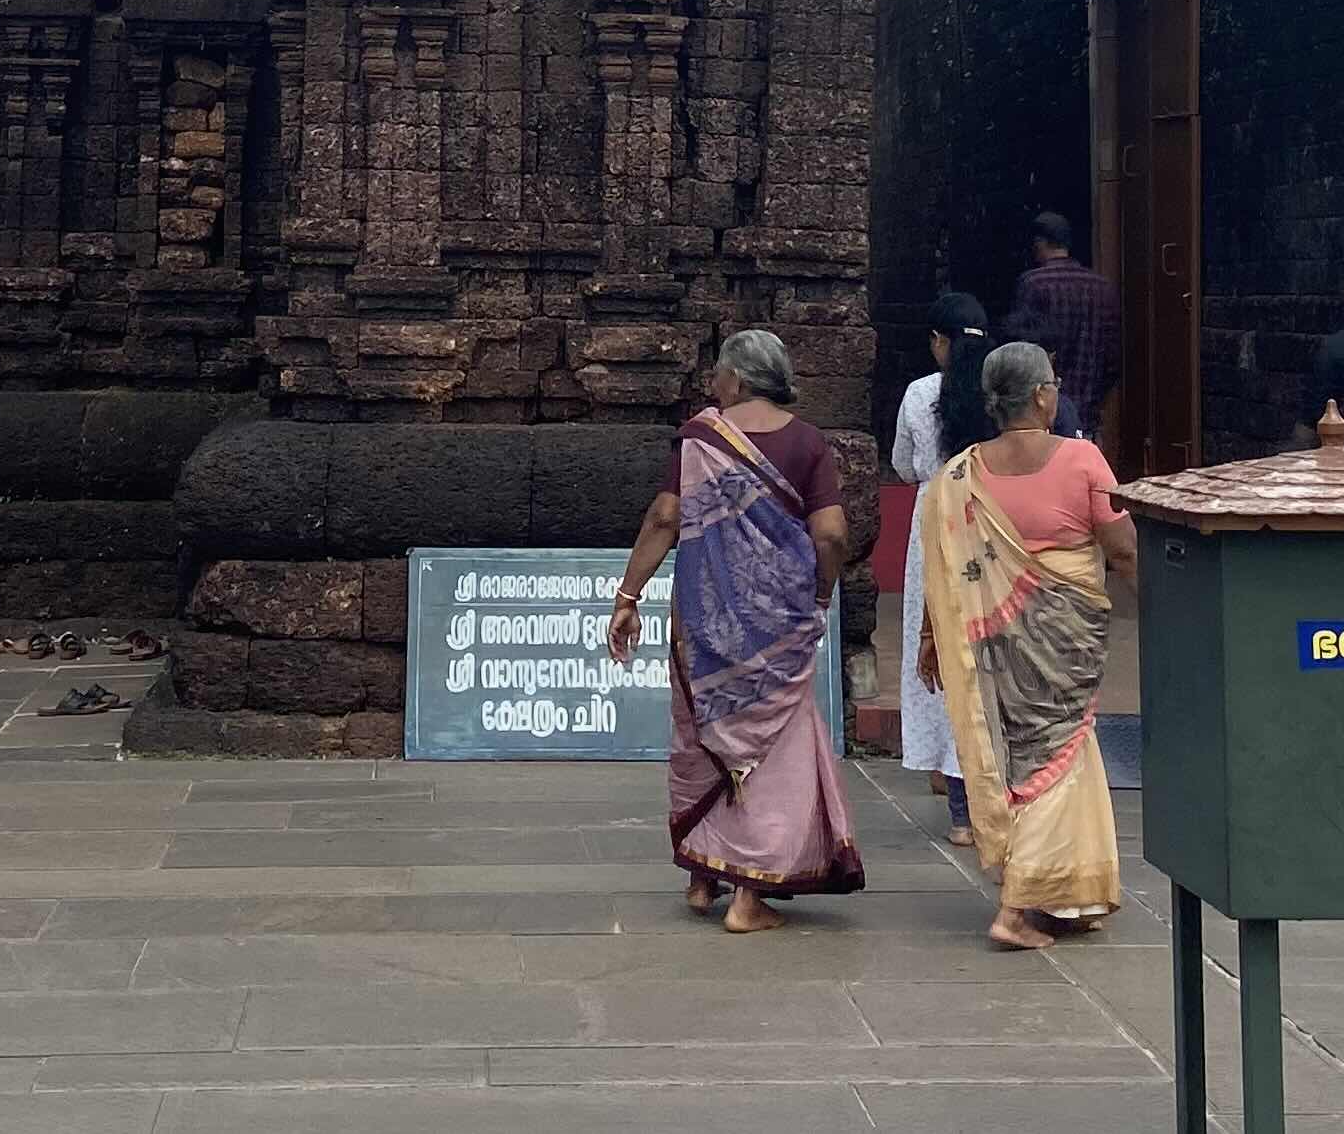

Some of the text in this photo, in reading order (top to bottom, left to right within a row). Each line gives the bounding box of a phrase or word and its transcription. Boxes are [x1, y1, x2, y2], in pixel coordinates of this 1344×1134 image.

[480, 574, 593, 600] രാജരാജേശ്വര
[481, 694, 617, 737] ക്ഷേത്രം ചിറ
